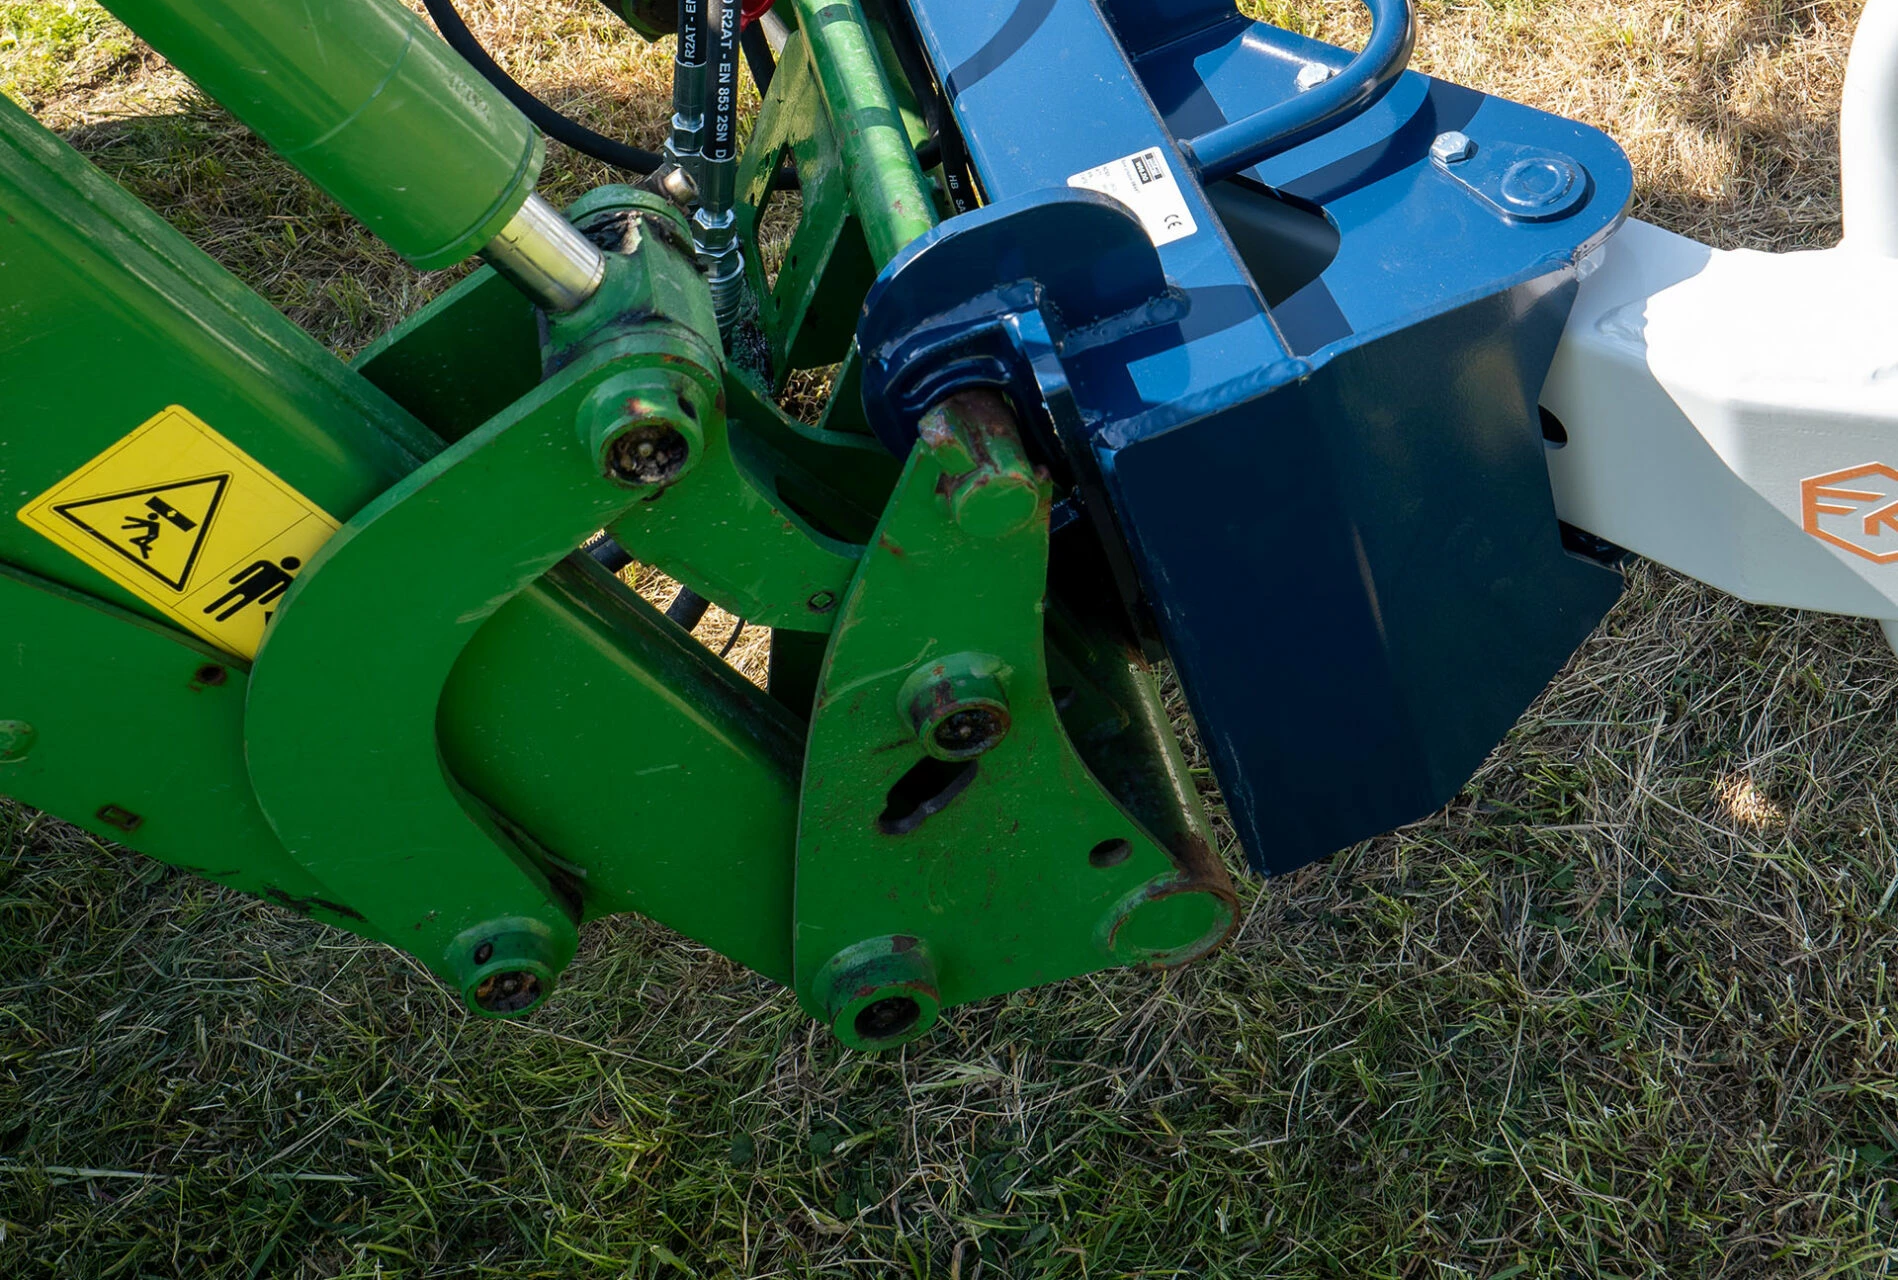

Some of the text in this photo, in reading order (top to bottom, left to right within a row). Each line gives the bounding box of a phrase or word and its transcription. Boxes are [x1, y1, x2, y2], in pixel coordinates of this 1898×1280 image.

[685, 24, 696, 59] R2AT
[721, 8, 734, 50] R2AT
[719, 63, 731, 84] EN
[717, 88, 730, 112] 853
[716, 115, 728, 142] 2SN
[949, 175, 966, 212] HB SA
